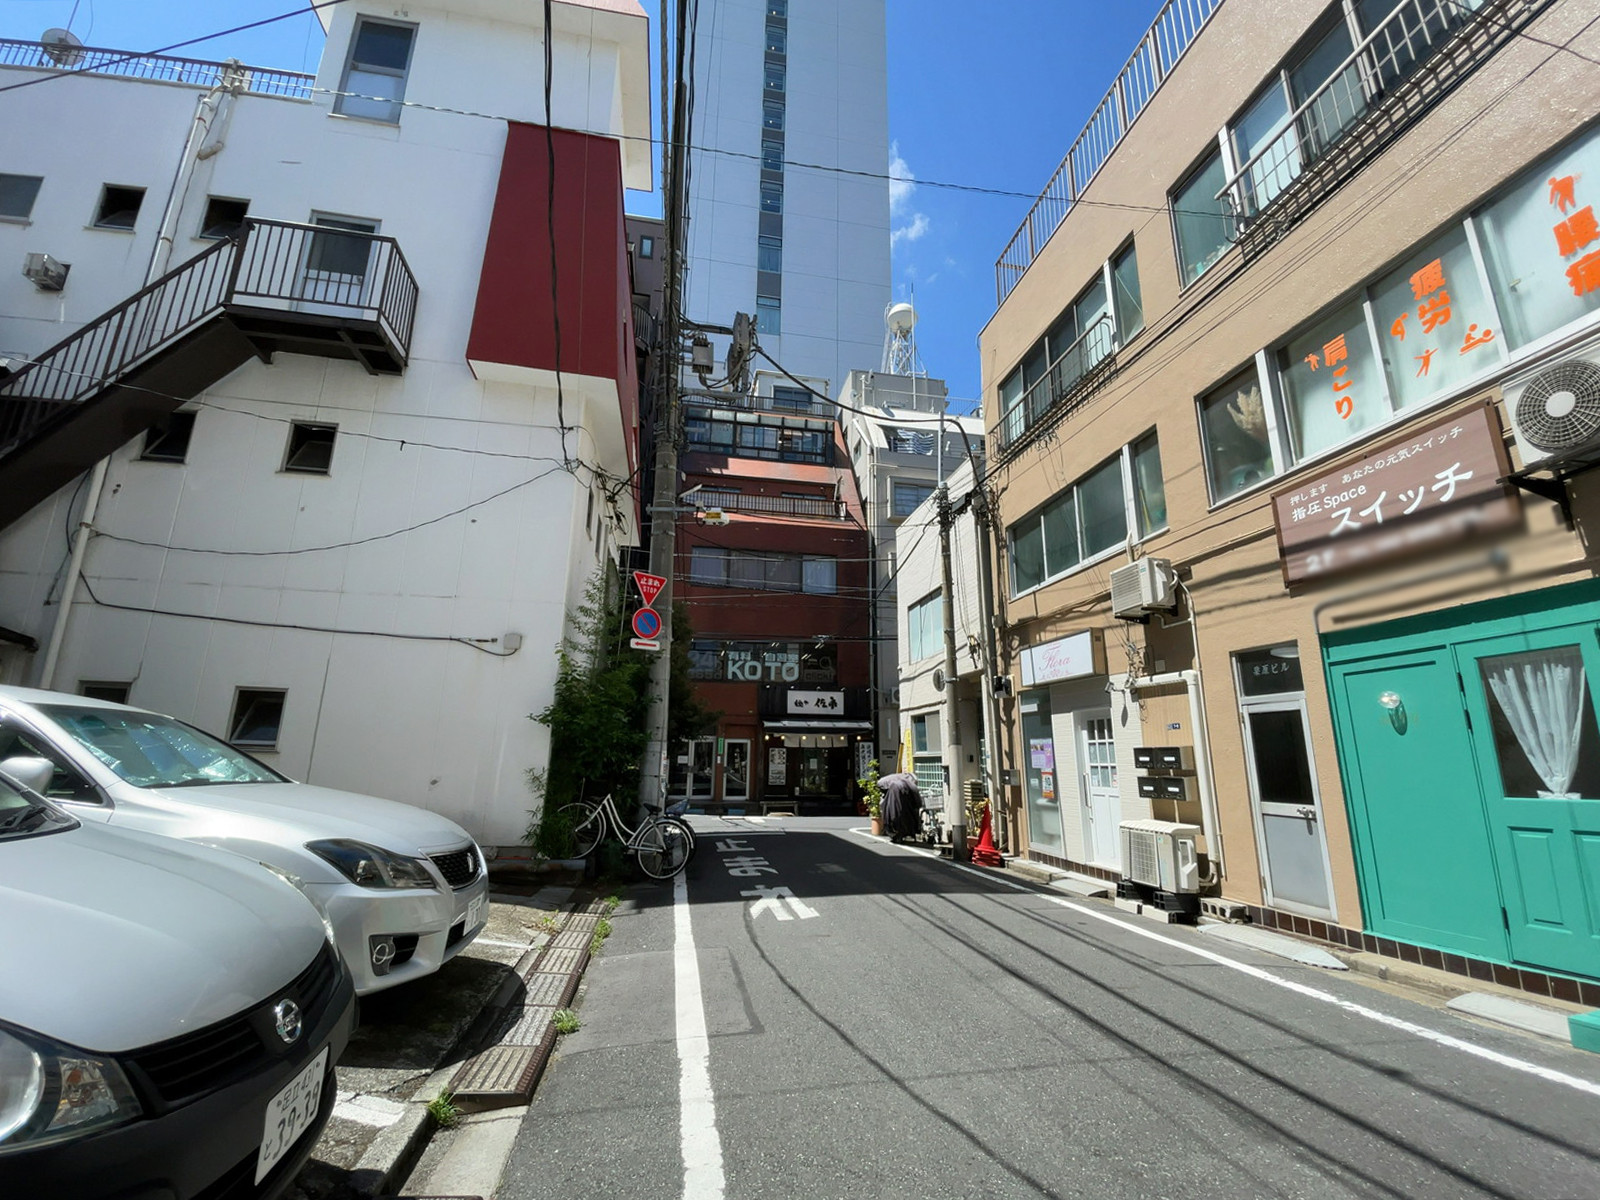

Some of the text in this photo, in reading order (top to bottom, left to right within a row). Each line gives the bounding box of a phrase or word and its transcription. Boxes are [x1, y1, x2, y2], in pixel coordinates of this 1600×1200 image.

[1408, 258, 1452, 335] 疲労
[1322, 333, 1353, 420] 肩こり
[1289, 425, 1464, 506] 押します あなたの元気スイッチ
[1329, 462, 1475, 537] スイッチ
[640, 576, 661, 587] 止まれ
[643, 585, 658, 594] STOP
[727, 661, 799, 682] KOTO
[715, 838, 821, 921] 止まれ
[264, 1080, 321, 1161] と 39-39
[281, 1080, 300, 1113] 足立
